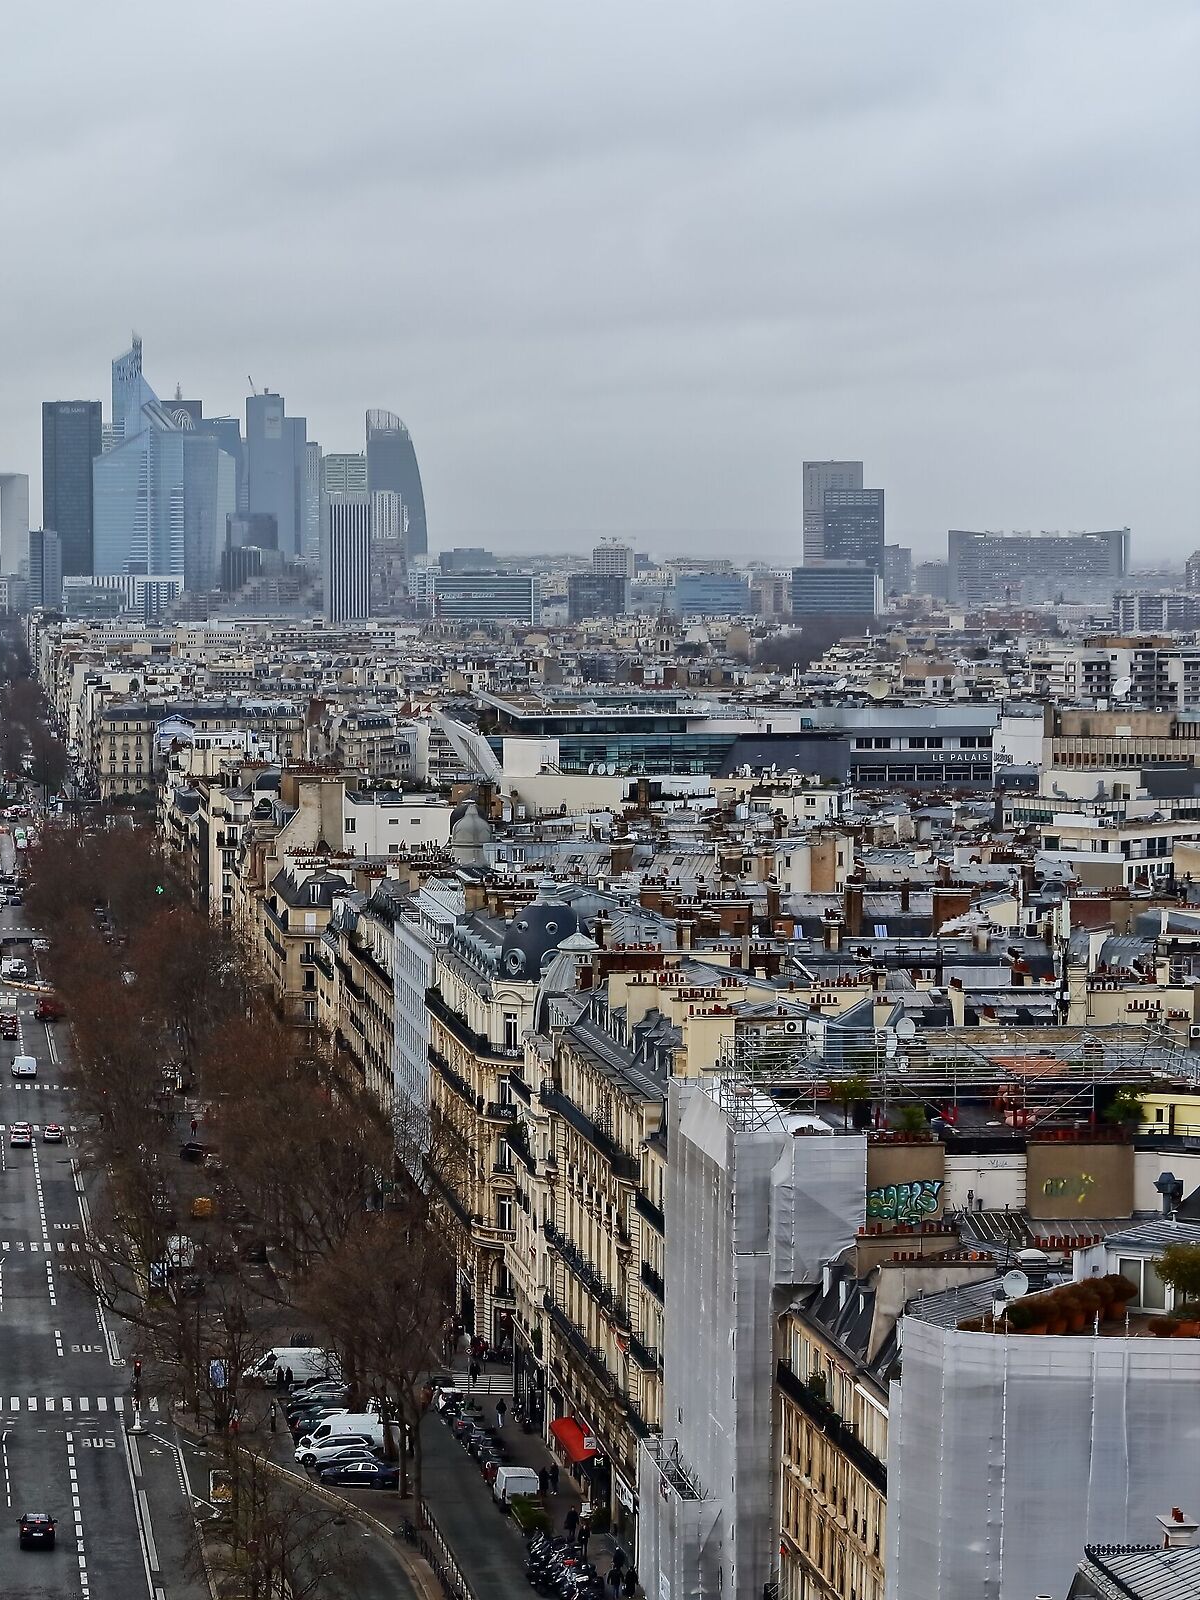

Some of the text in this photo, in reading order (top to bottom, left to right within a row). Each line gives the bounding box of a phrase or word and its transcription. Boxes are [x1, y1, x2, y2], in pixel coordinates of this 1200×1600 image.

[932, 753, 944, 761] LE
[950, 753, 988, 761] PALAIS
[71, 1344, 104, 1353] BUS
[81, 1438, 117, 1448] BUS
